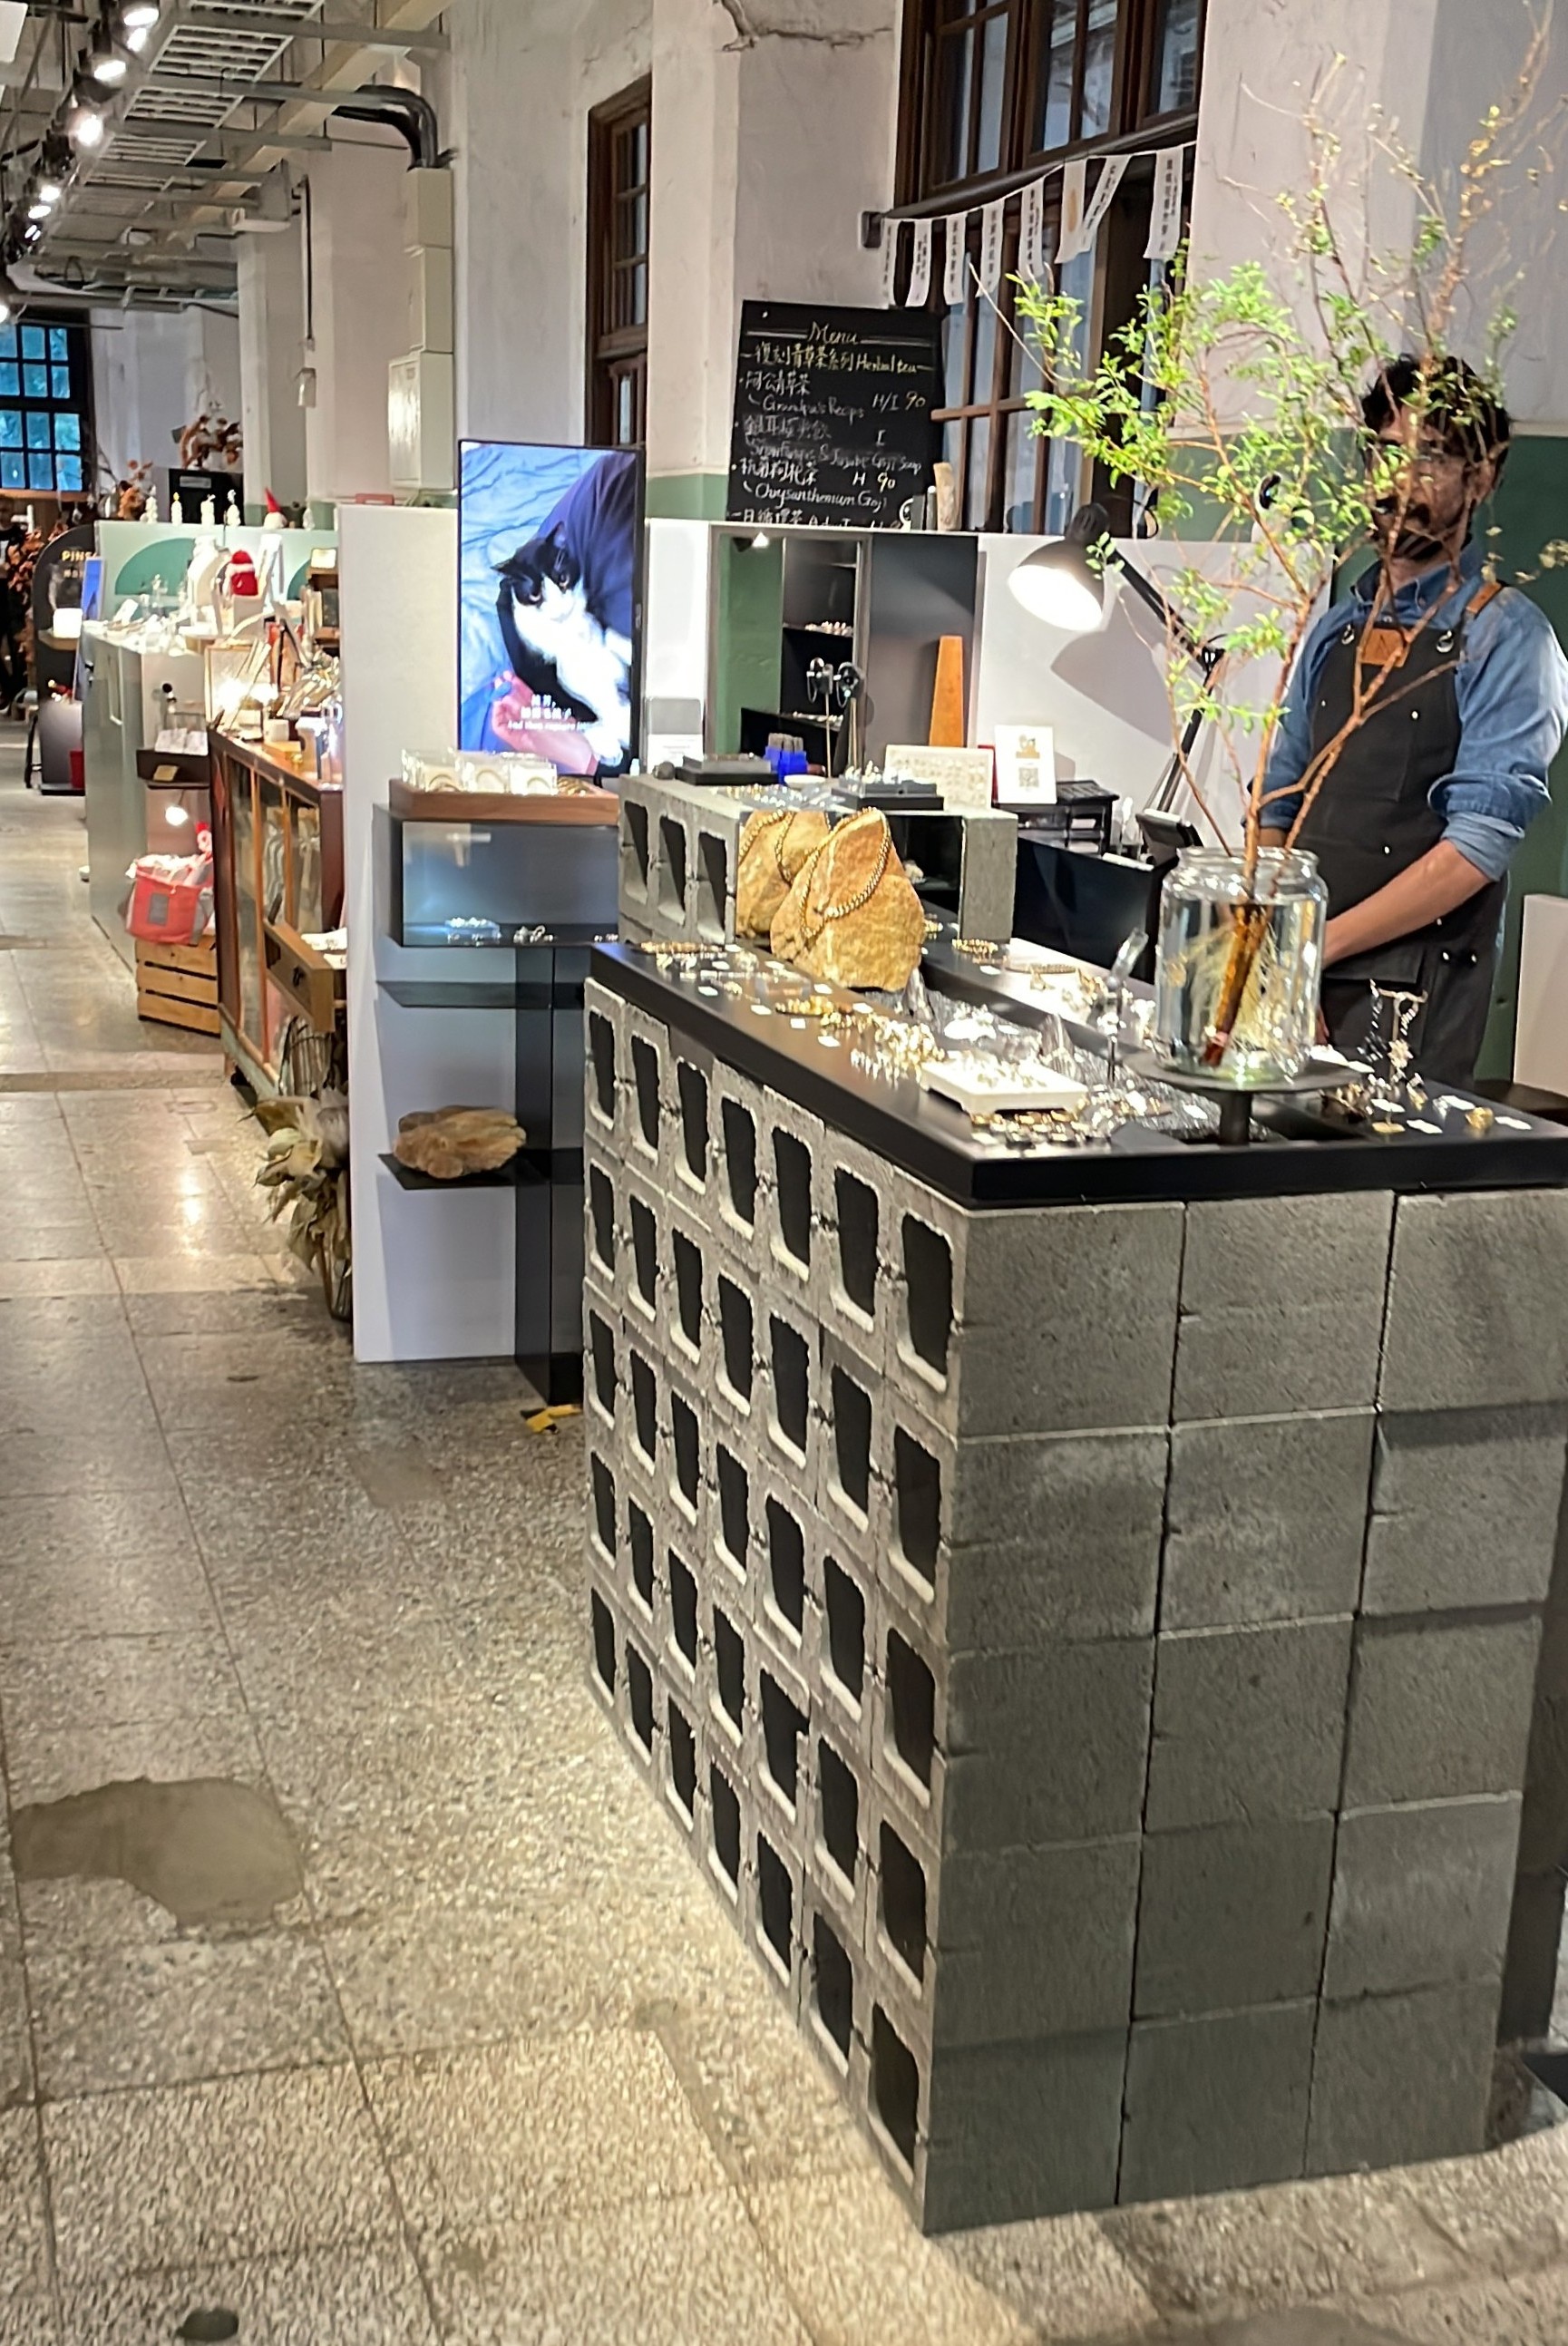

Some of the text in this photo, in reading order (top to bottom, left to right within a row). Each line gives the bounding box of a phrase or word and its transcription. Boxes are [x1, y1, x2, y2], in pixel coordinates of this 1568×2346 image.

[808, 321, 859, 345] Menu
[872, 391, 926, 413] H/I 90
[874, 429, 887, 446] I
[852, 470, 897, 492] H 90
